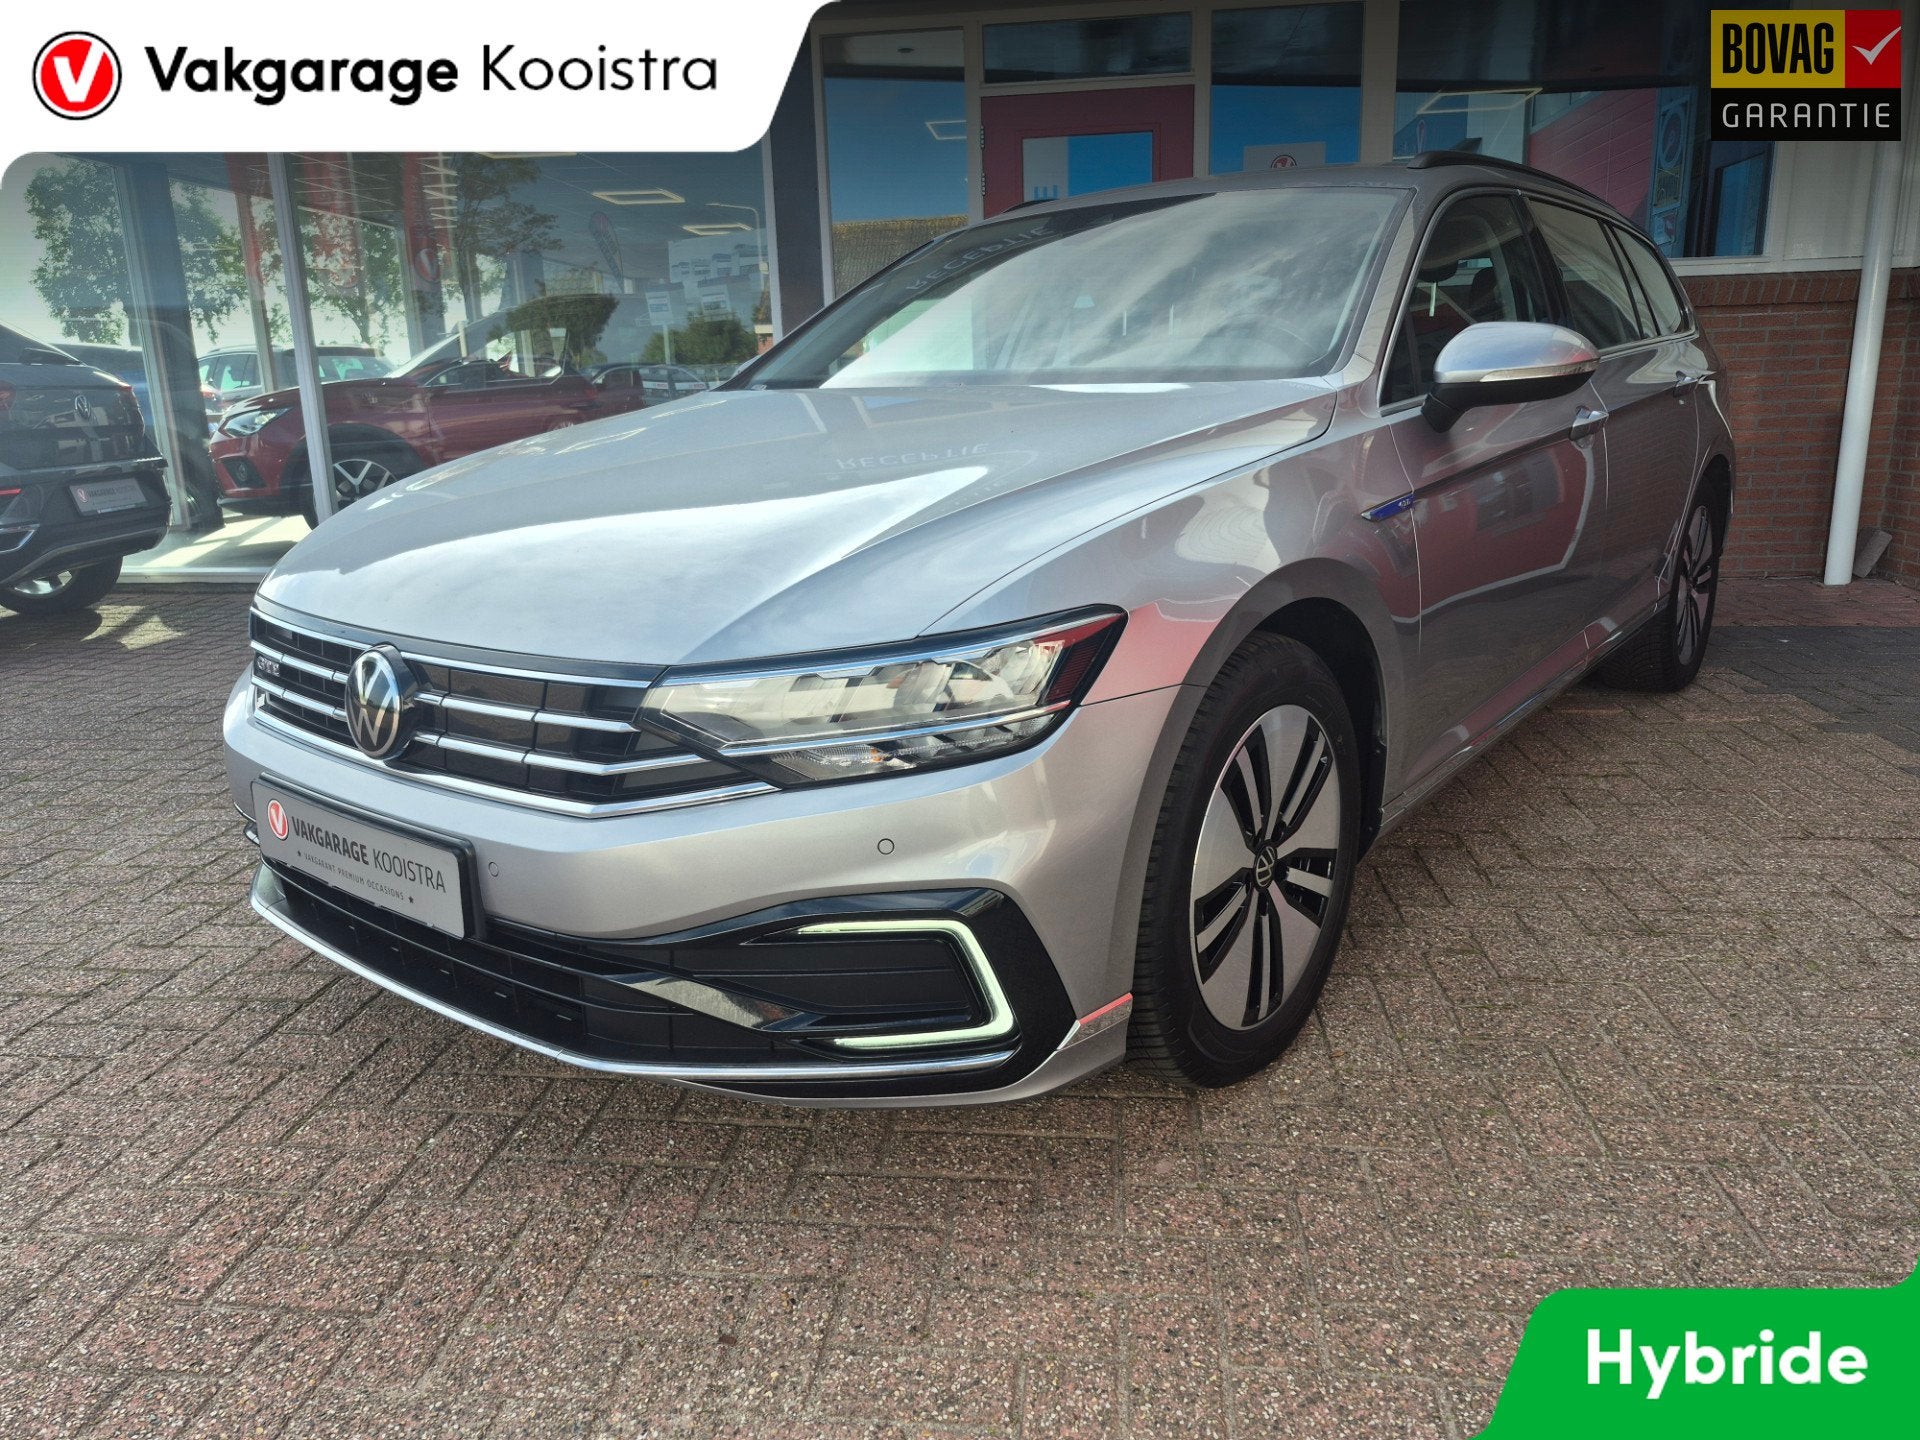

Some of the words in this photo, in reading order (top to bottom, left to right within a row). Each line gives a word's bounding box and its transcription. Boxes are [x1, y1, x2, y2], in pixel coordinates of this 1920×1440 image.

[291, 816, 370, 866] VAKGARAGE
[372, 847, 447, 894] KOOISTRA
[337, 866, 366, 886] PREMIUM
[366, 878, 405, 901] OCCASIONS
